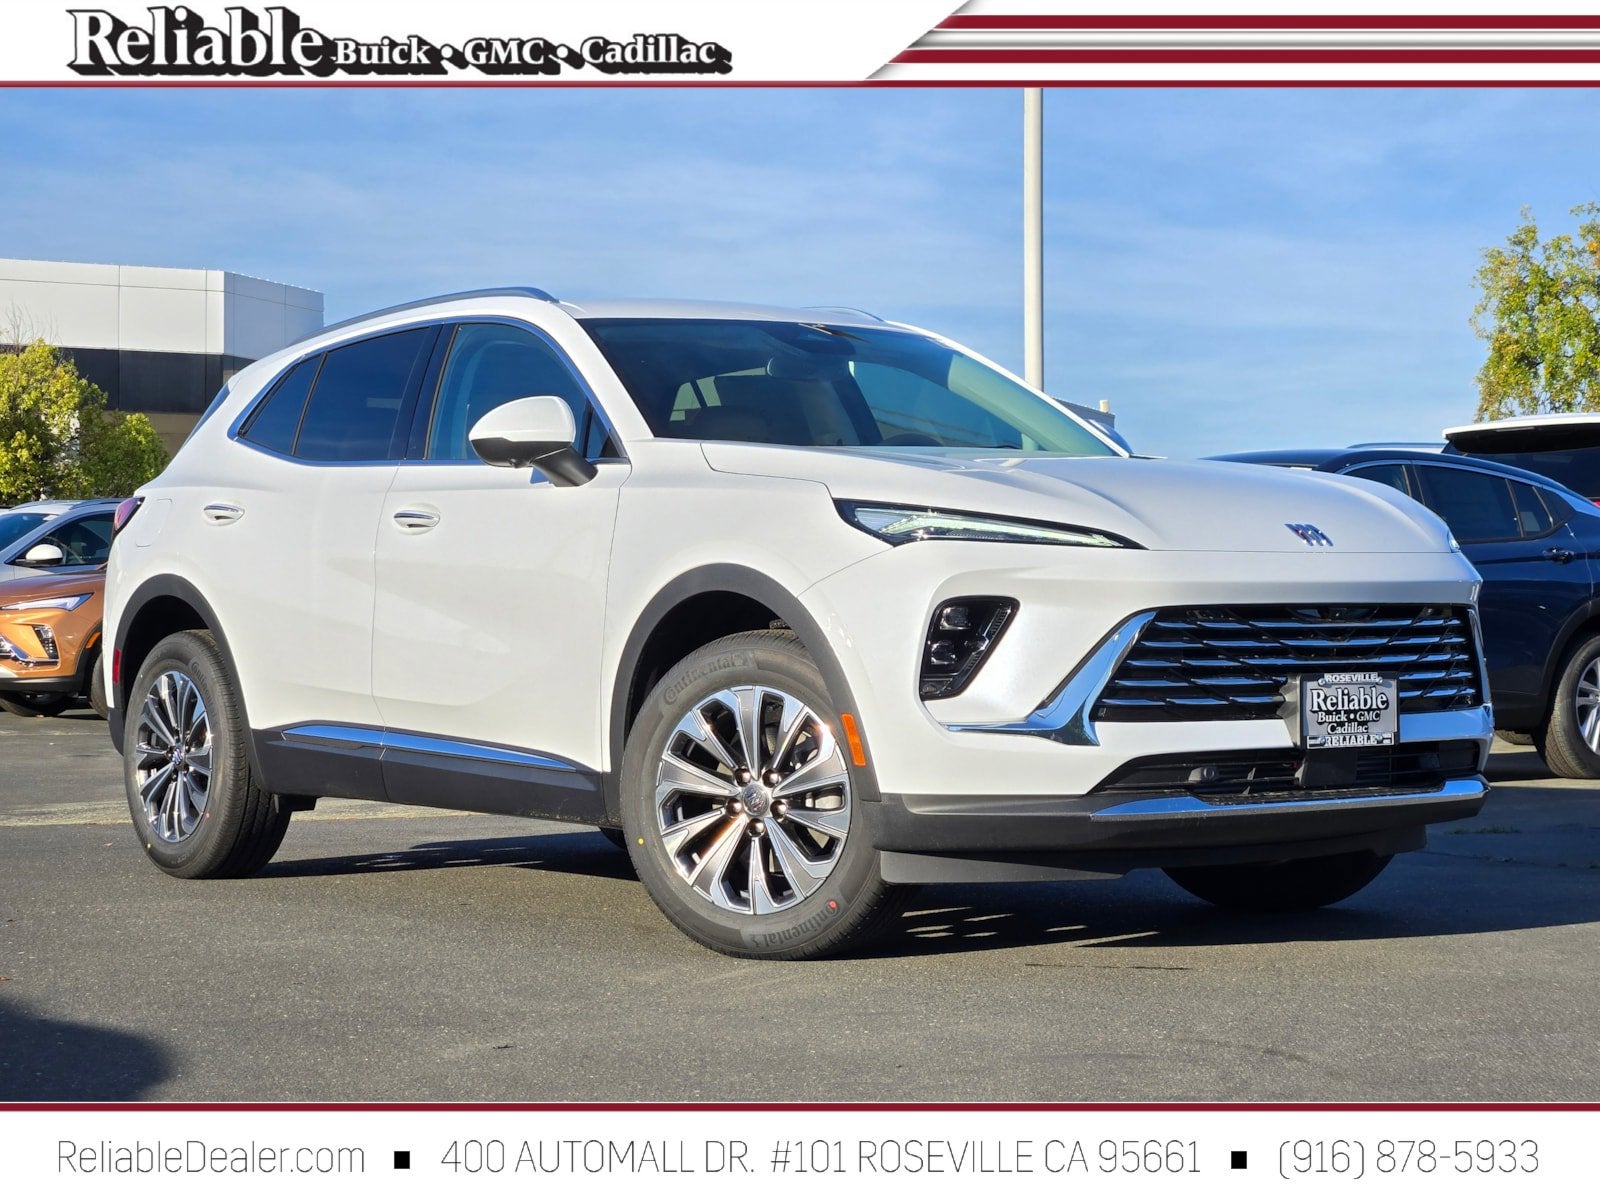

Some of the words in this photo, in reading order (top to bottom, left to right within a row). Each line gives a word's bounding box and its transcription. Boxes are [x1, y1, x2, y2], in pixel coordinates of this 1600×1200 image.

[1325, 673, 1378, 683] ROSEVILLE
[1310, 686, 1389, 713] Reliable
[1317, 711, 1348, 725] Buick
[1356, 710, 1381, 722] GMC
[1327, 722, 1369, 735] Cadillac
[1325, 734, 1378, 747] RELIABLE
[763, 900, 838, 948] Continental
